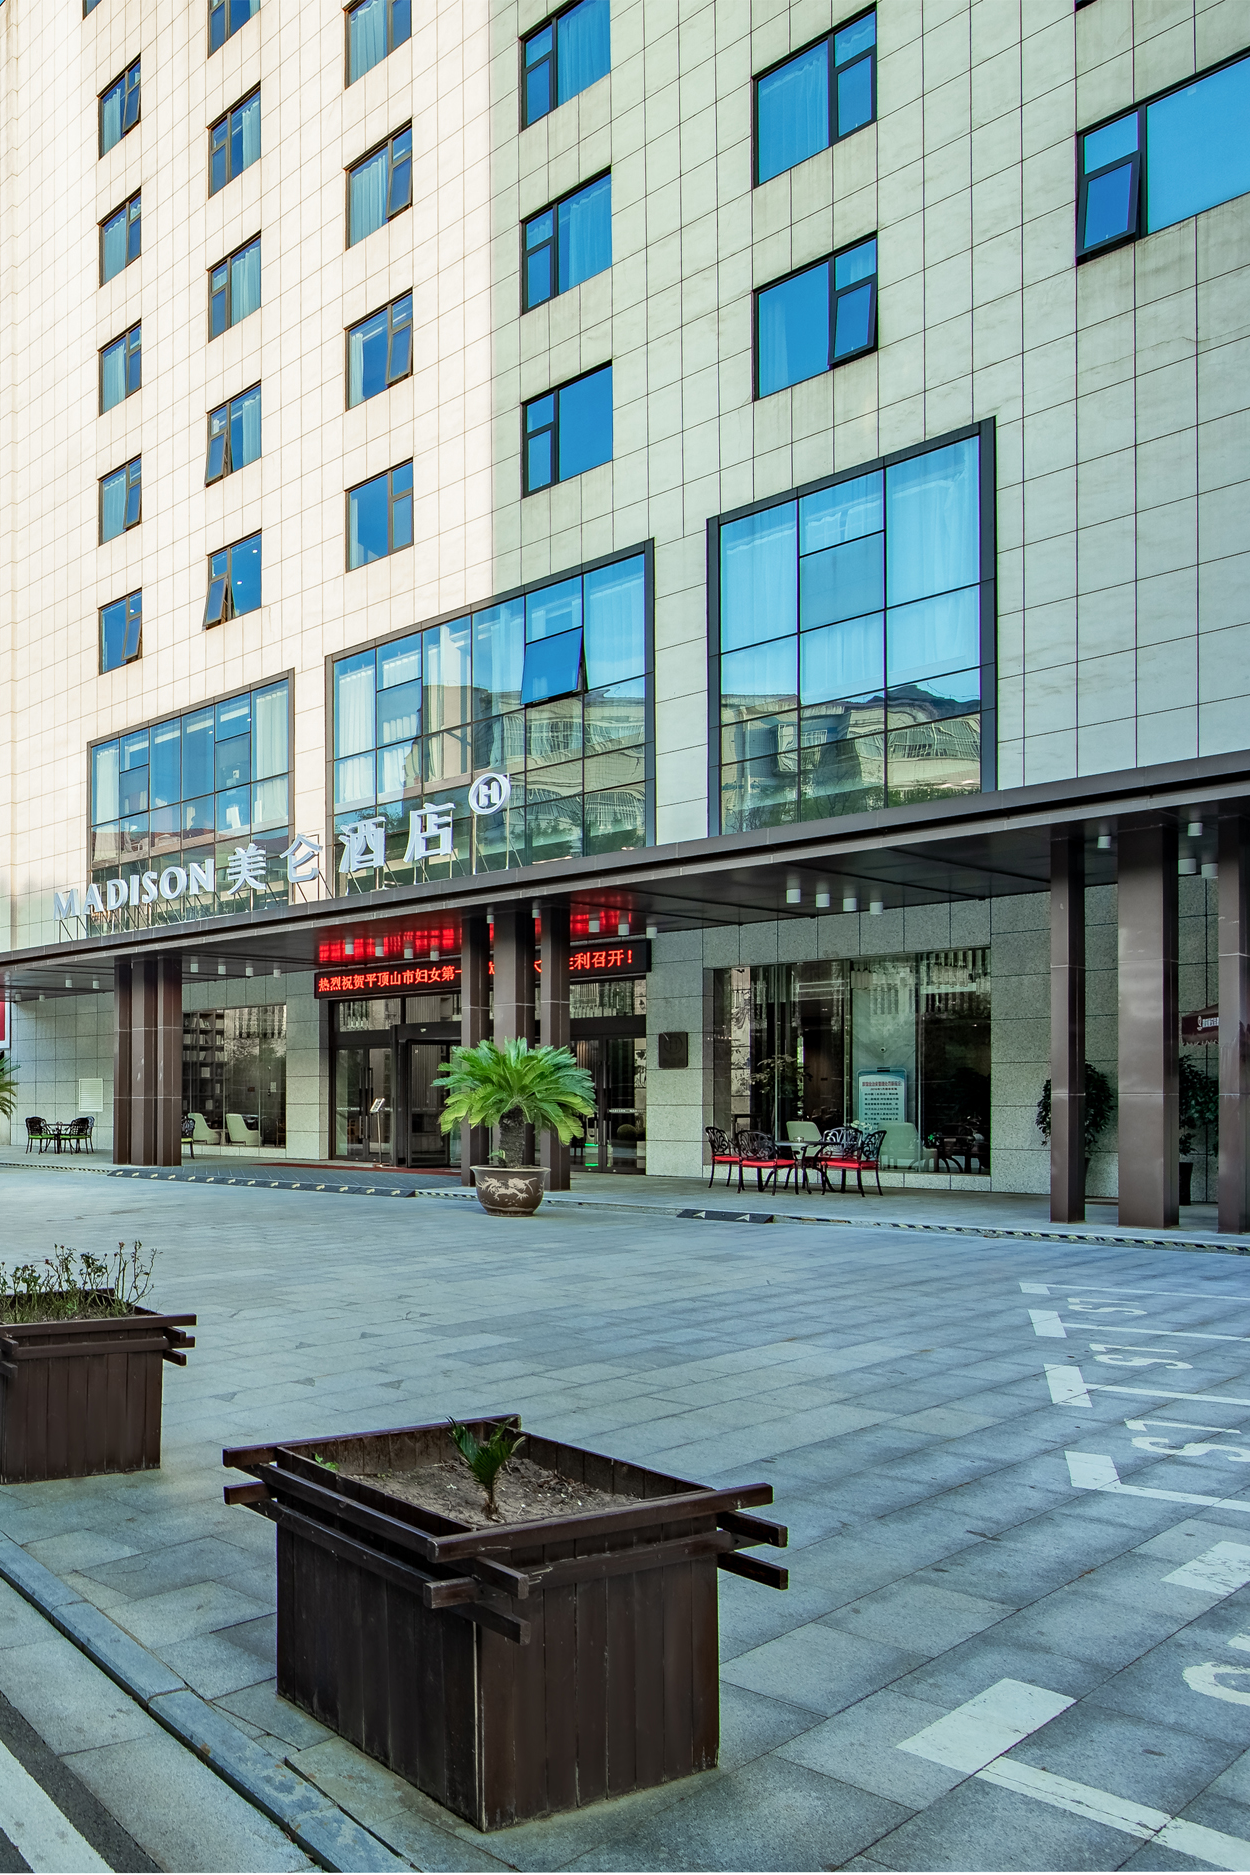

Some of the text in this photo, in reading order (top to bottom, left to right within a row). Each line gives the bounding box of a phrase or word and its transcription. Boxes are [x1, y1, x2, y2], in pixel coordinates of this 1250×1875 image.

[53, 802, 456, 921] MADISON 美仑酒店
